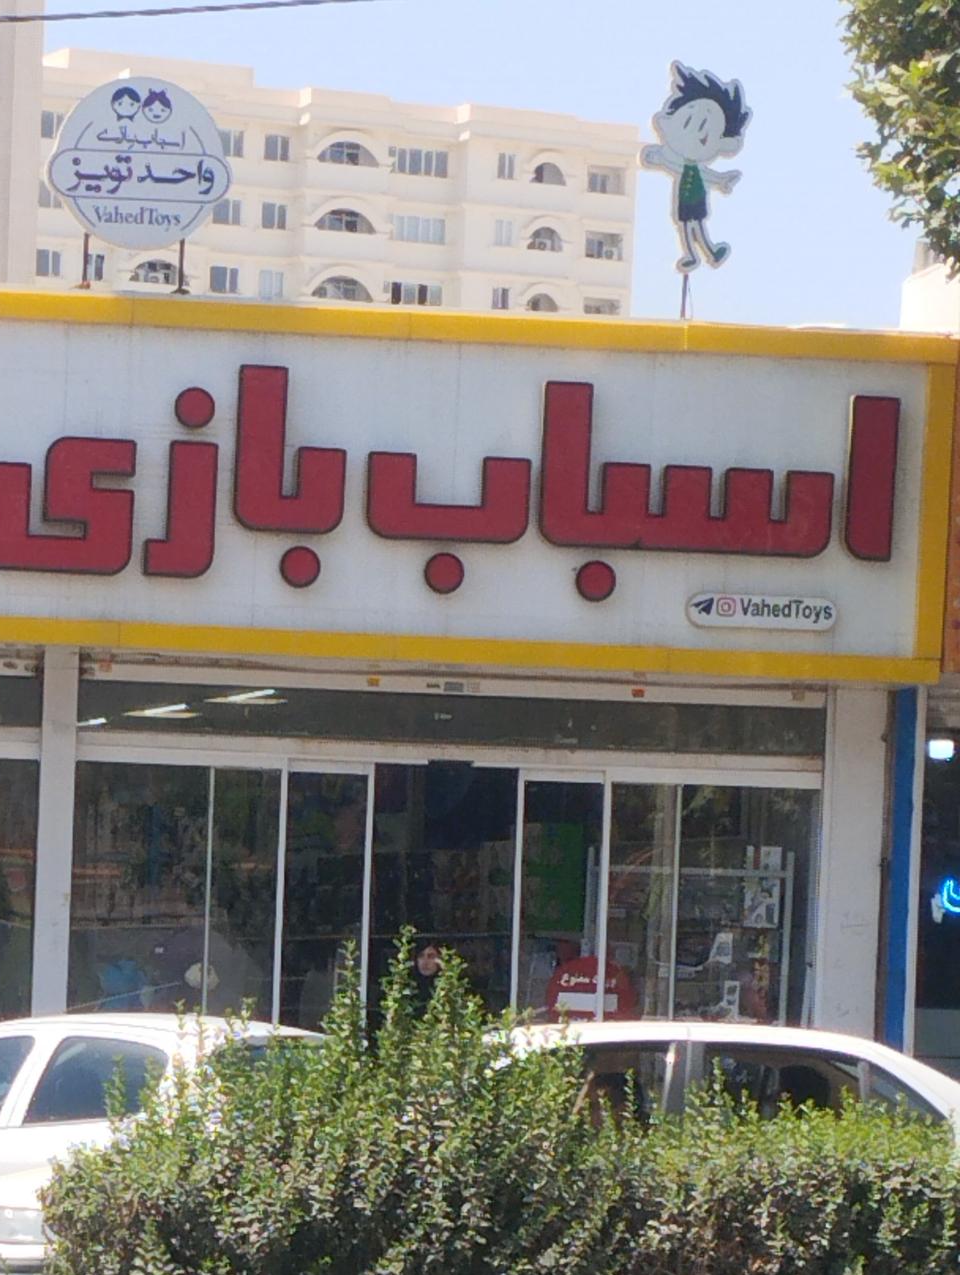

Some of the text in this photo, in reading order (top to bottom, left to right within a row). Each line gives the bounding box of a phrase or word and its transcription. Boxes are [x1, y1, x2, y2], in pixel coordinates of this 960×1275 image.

[137, 159, 215, 195] واحد
[366, 381, 901, 602] اسباب
[740, 597, 833, 624] VahedToys
